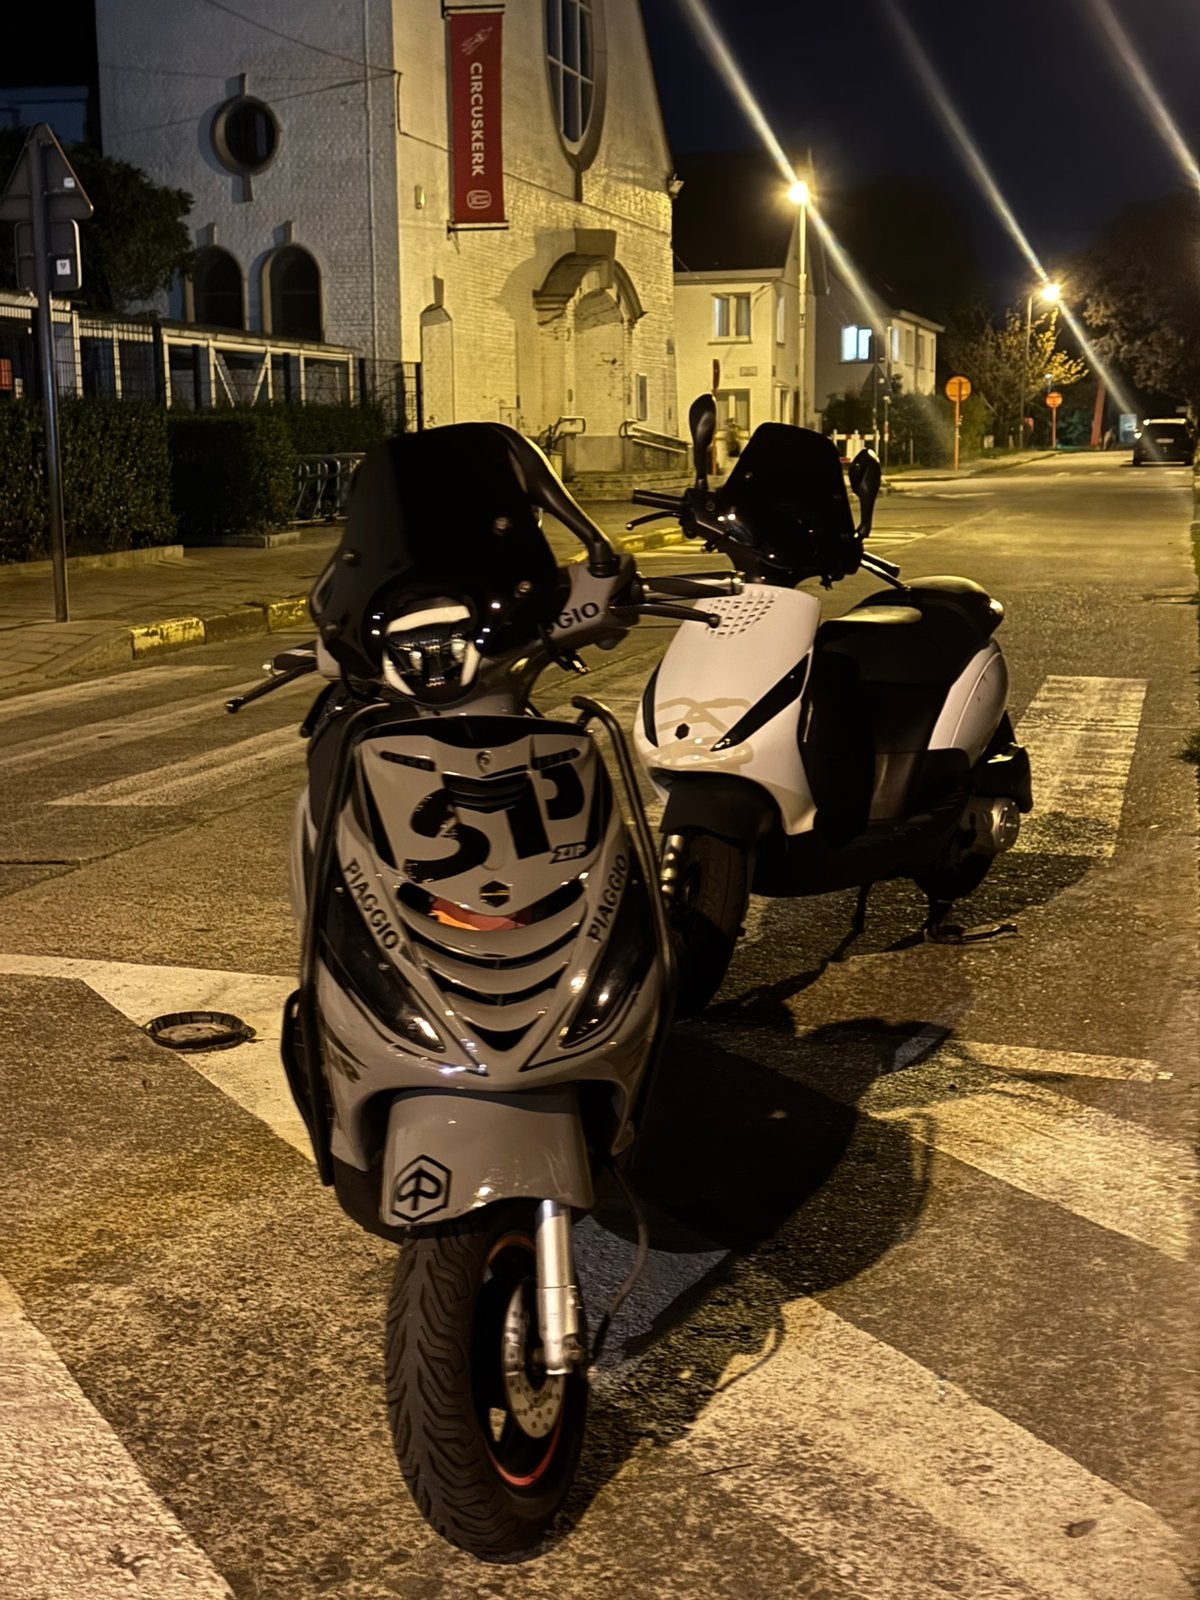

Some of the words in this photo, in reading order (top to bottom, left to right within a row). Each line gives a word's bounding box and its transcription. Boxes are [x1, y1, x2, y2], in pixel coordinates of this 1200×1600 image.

[470, 62, 485, 177] CIRCUSKERK
[551, 842, 588, 864] ZIP
[342, 859, 399, 949] PIAGGIO
[586, 854, 627, 942] PIAGGIO
